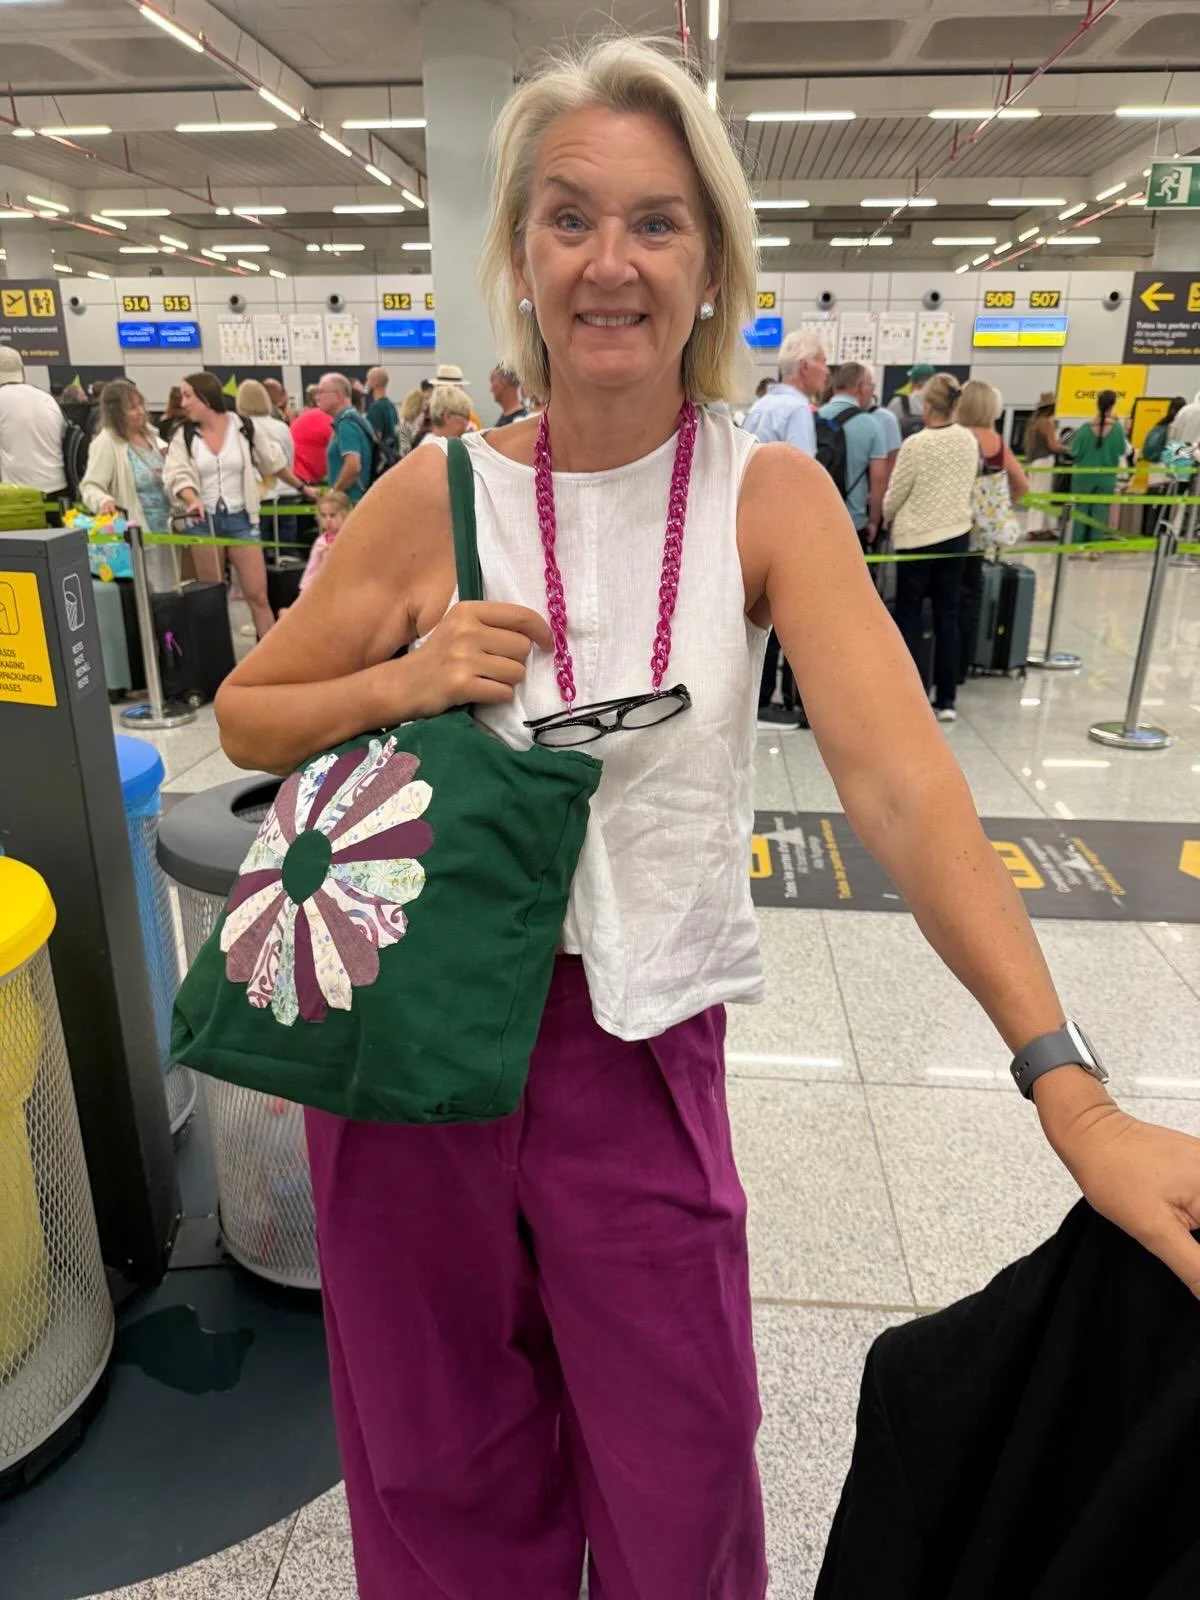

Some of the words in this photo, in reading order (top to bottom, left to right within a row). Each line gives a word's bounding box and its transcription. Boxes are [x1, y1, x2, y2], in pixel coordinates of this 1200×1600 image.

[124, 296, 149, 310] 514
[164, 296, 190, 310] 513
[384, 294, 410, 309] 512
[756, 293, 775, 307] 09
[985, 292, 1014, 307] 508
[1030, 292, 1060, 307] 507
